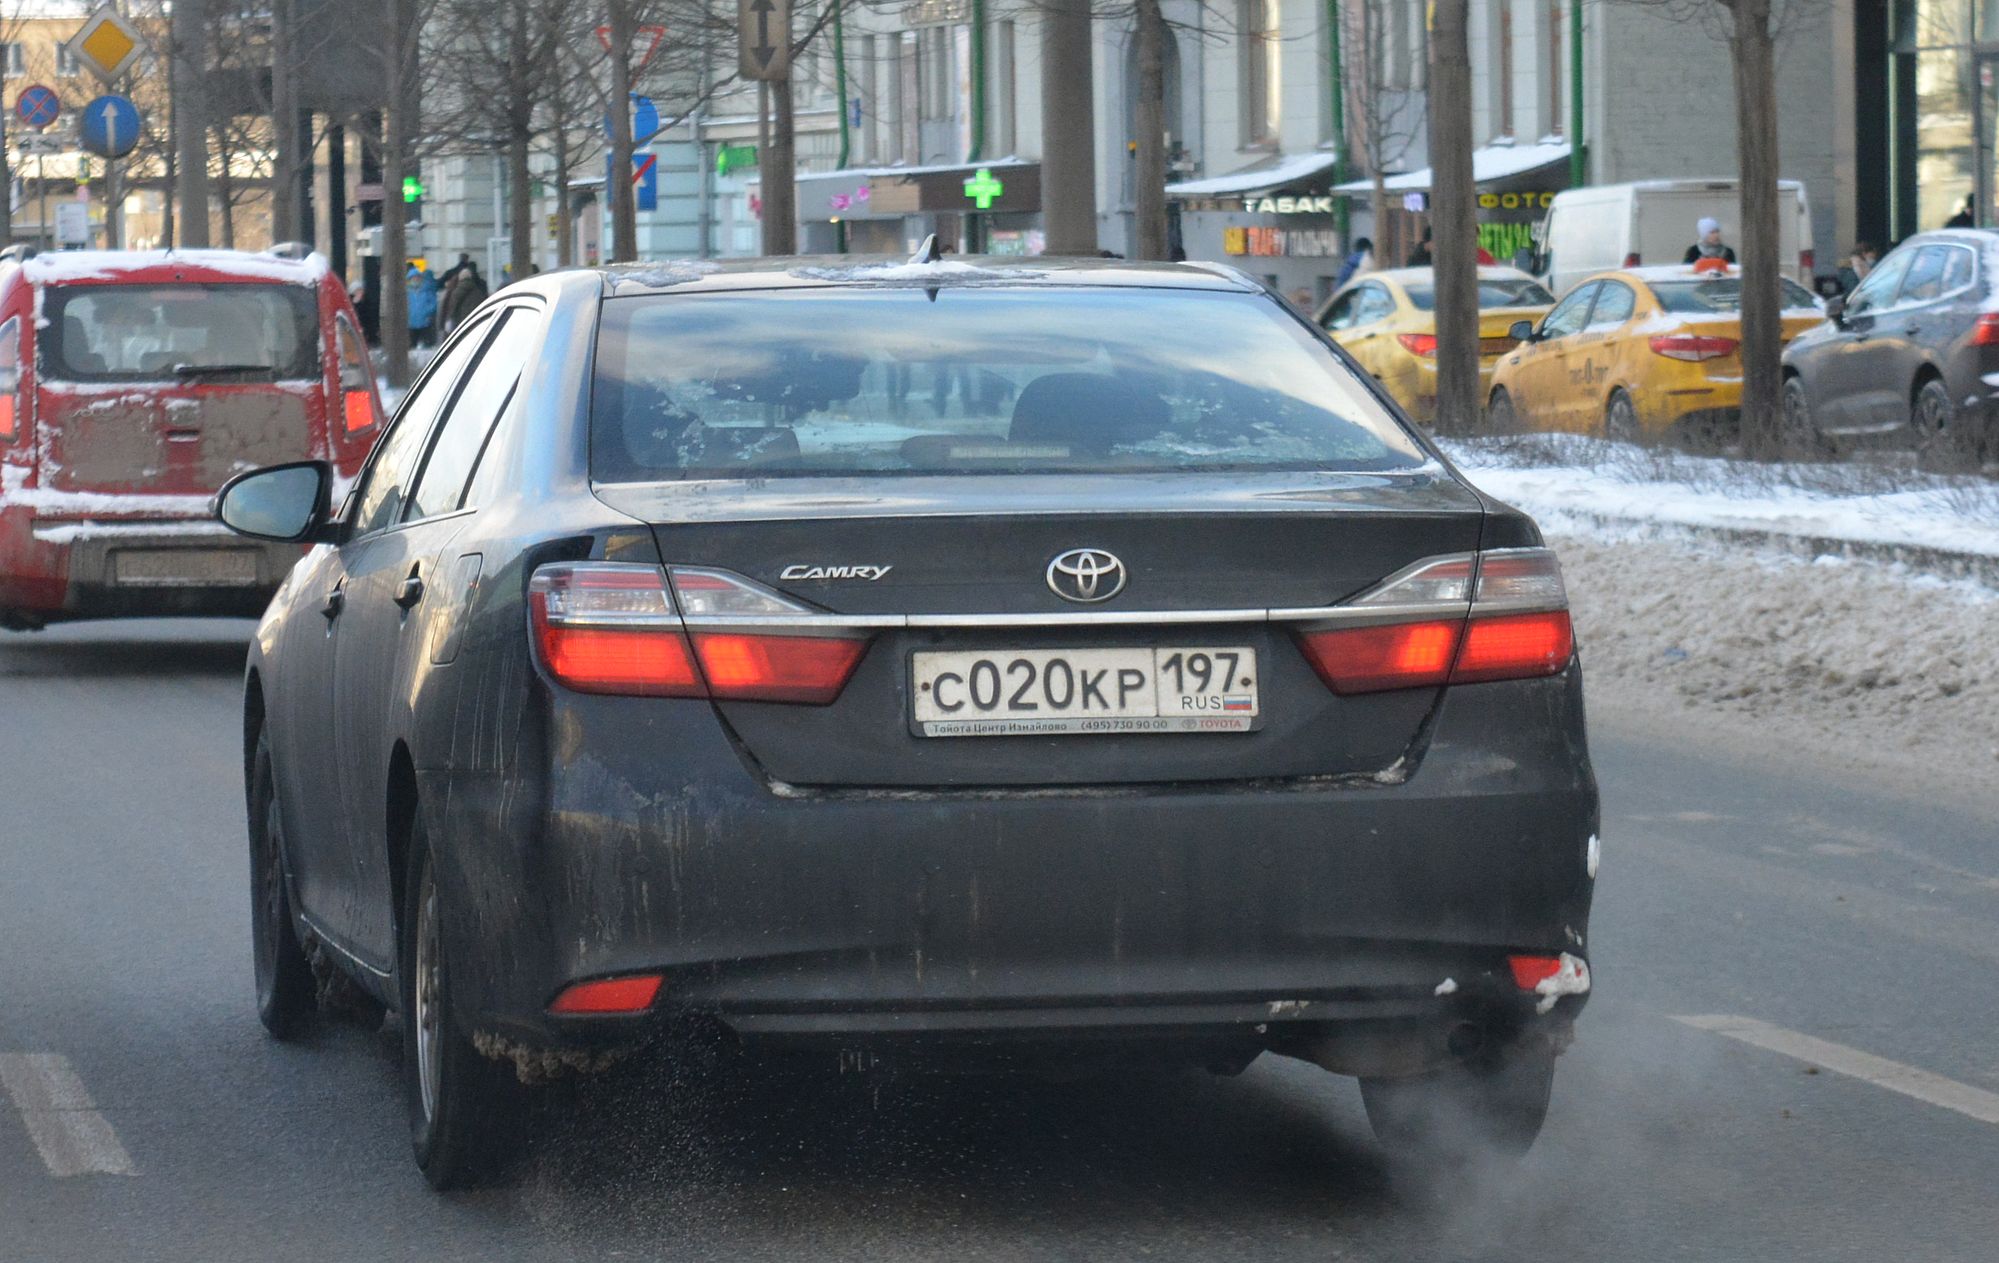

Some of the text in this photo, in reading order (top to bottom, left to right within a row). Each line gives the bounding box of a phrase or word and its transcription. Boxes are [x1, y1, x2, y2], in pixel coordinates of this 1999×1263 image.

[1241, 197, 1333, 213] ТАБАК
[1479, 192, 1555, 209] ФОТО
[780, 564, 894, 580] CAMRY
[1161, 652, 1240, 693] 197
[1181, 695, 1221, 710] RUS
[934, 720, 1168, 734] Тойота Центр Измайлово (495) 730 90 00
[1200, 719, 1242, 729] TOYOTA
